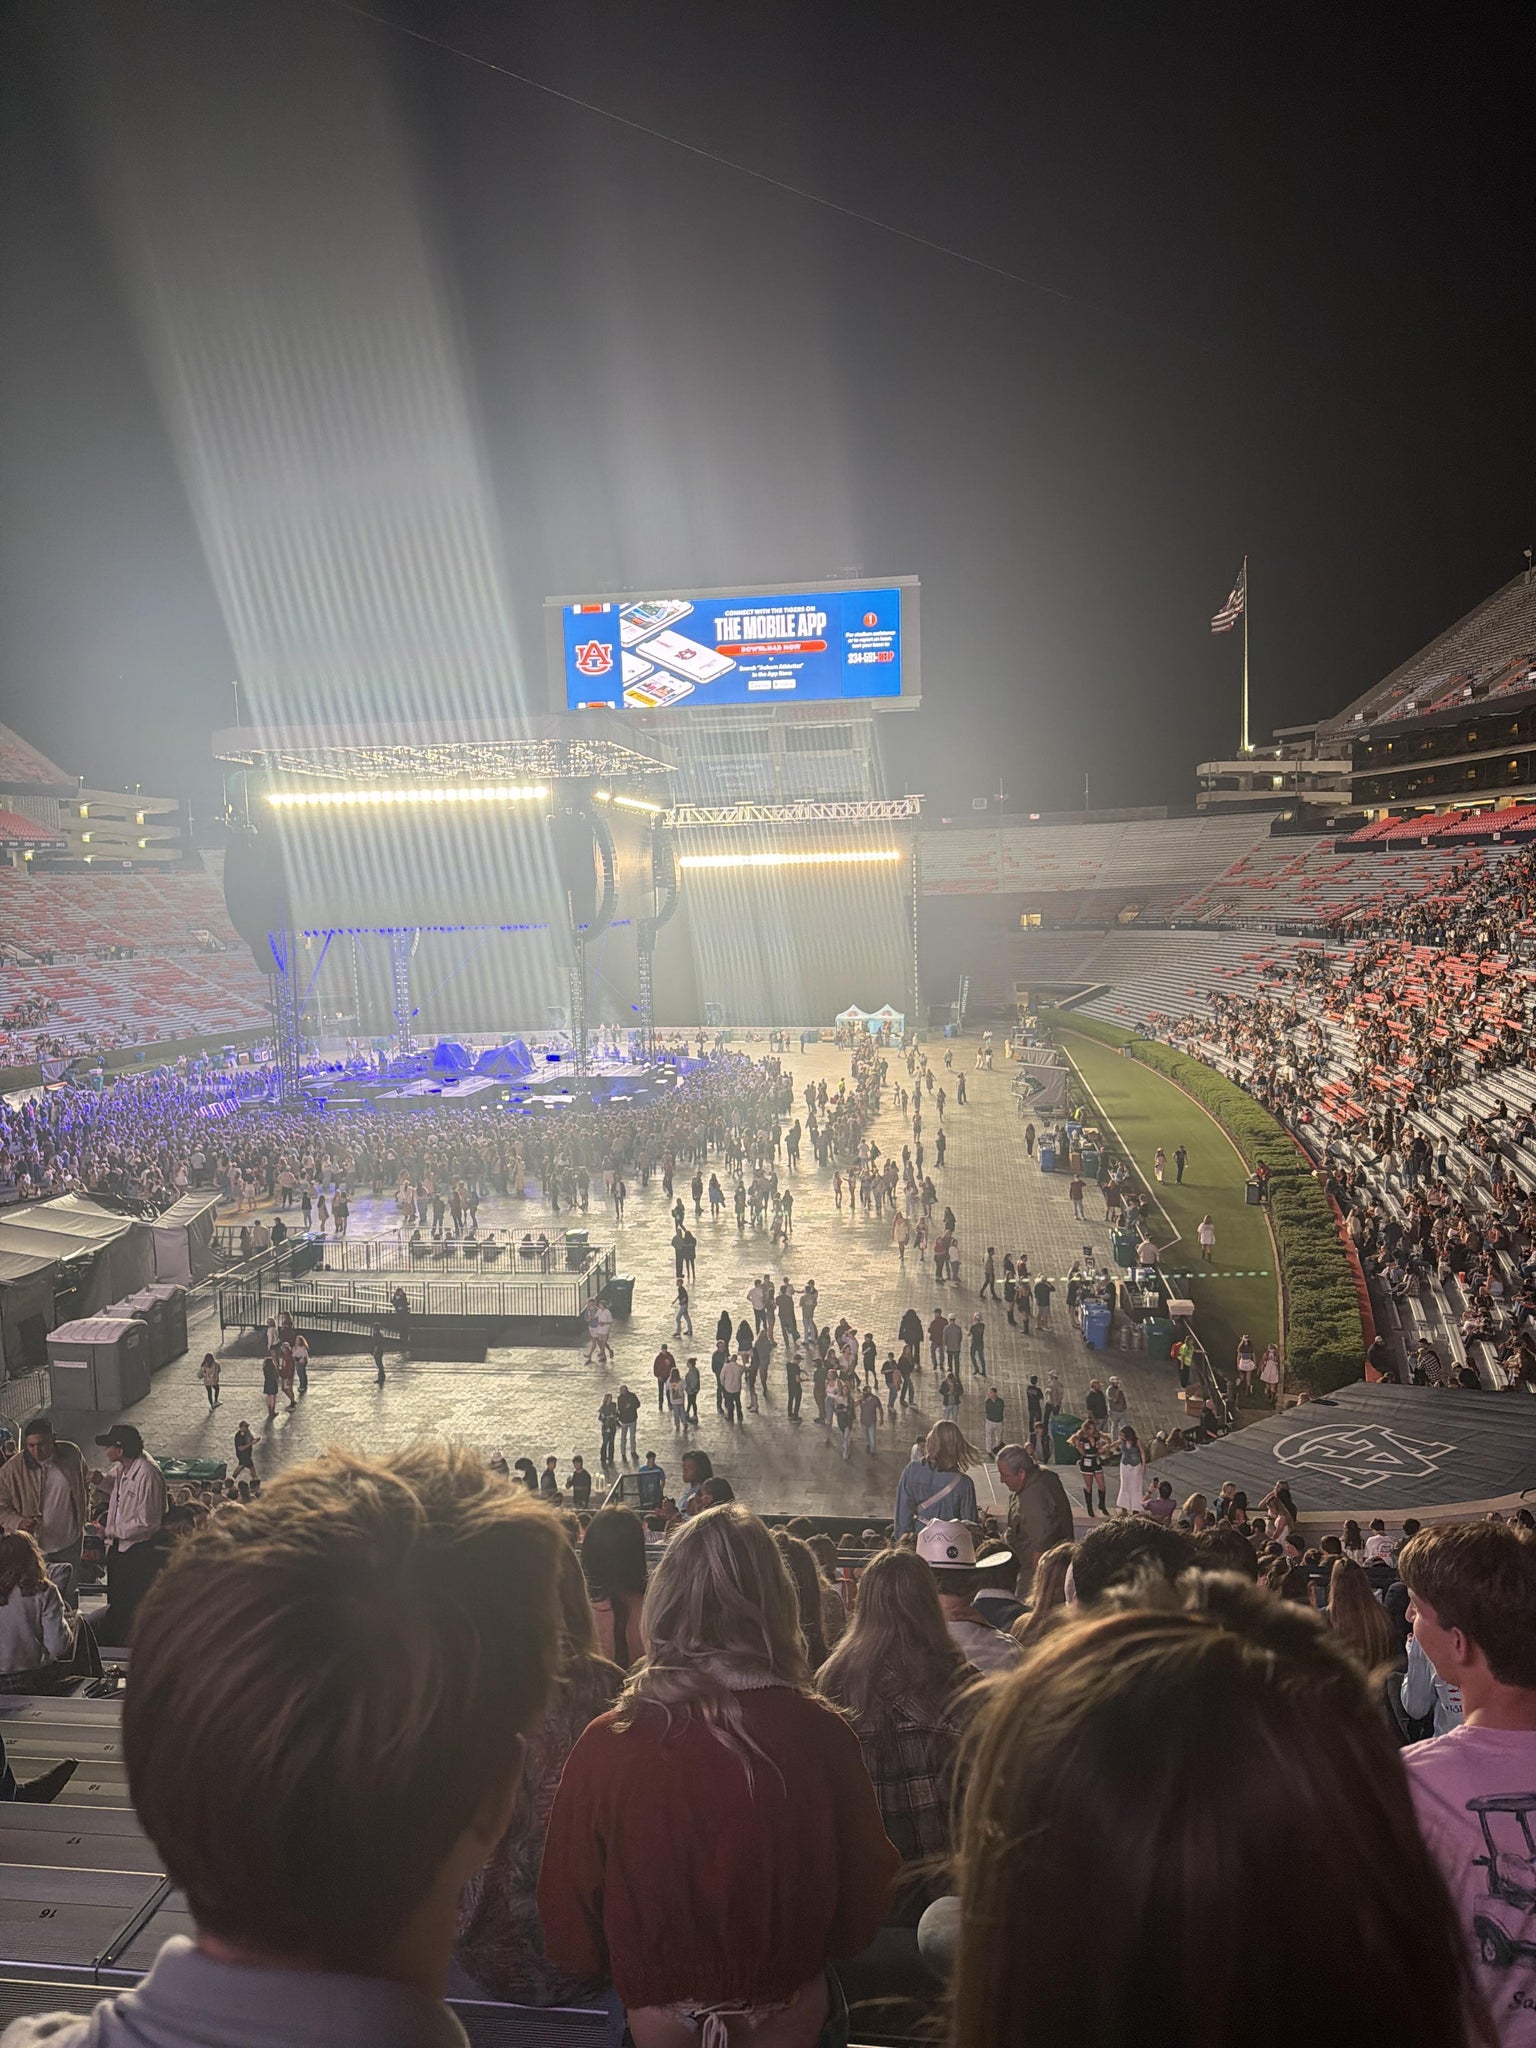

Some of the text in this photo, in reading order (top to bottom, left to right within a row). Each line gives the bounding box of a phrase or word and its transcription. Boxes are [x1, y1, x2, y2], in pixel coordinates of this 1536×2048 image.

[714, 612, 827, 641] THE MOBILE APP
[741, 643, 801, 653] DOWNLOAD NOW
[66, 1837, 82, 1845] 17
[39, 1908, 58, 1919] 16
